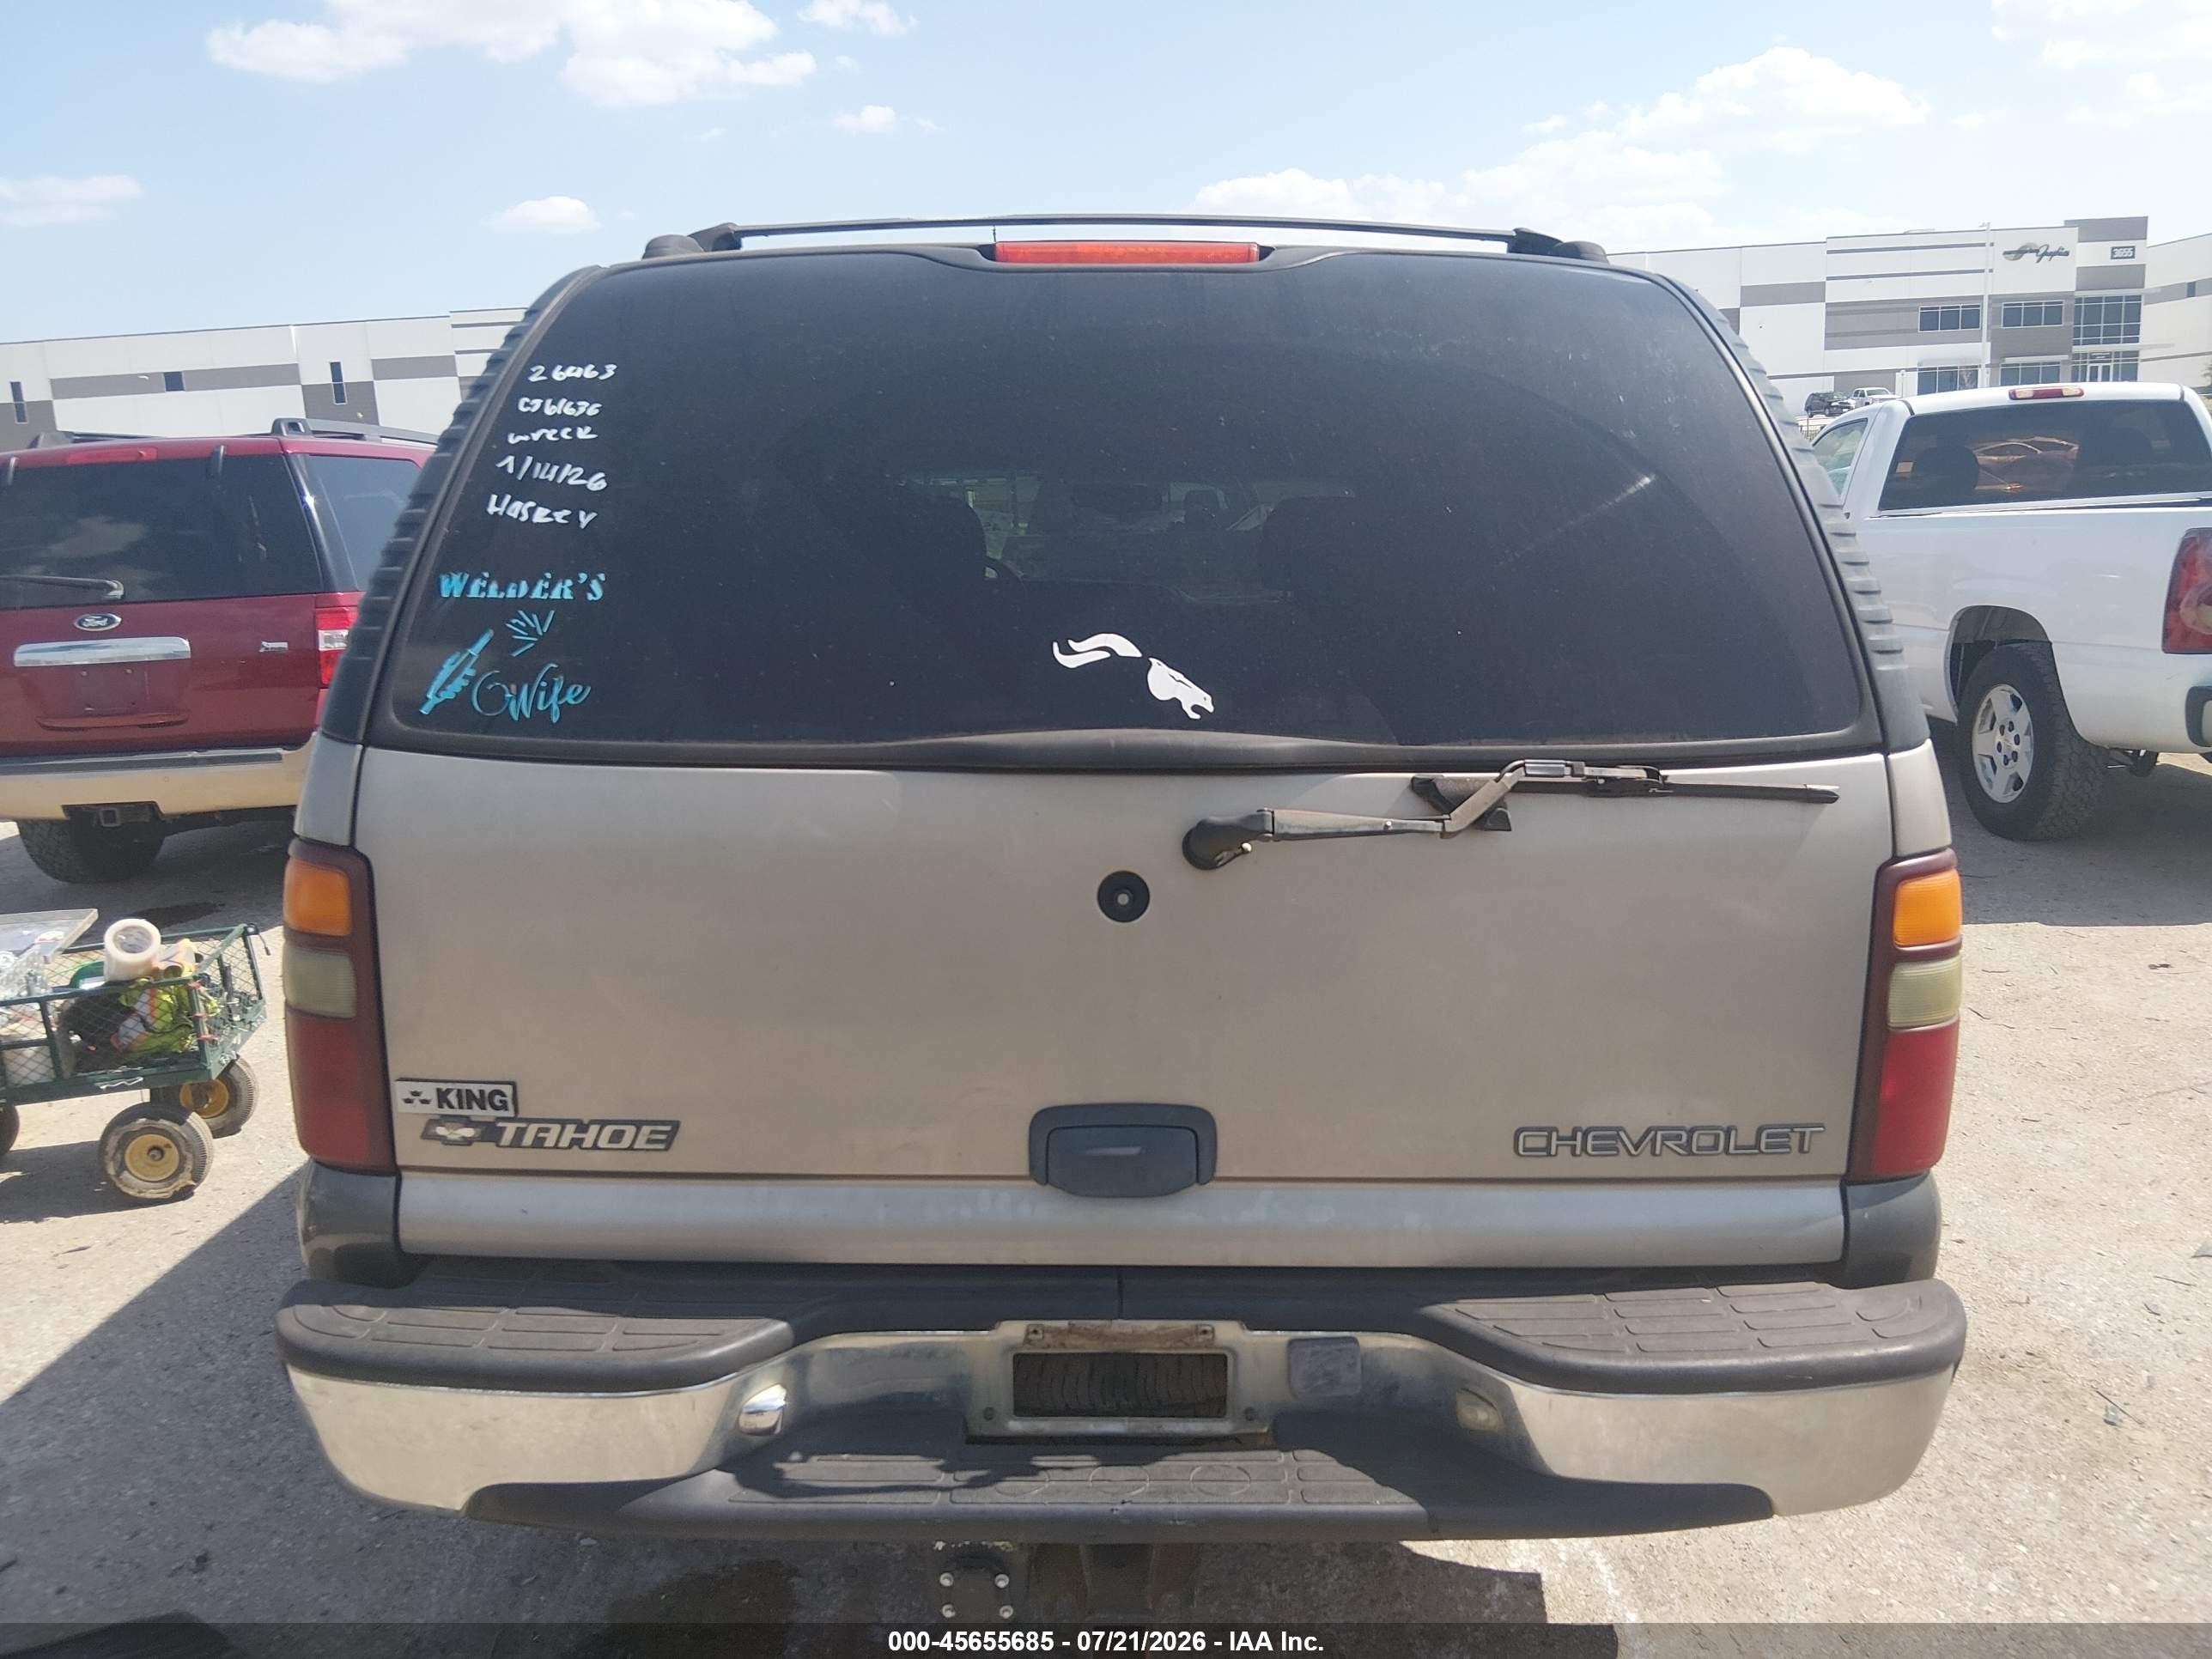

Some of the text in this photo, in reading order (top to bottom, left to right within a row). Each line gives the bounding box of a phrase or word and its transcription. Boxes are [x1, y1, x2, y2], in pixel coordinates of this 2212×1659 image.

[472, 663, 592, 724] Wife
[435, 1087, 509, 1112] KING
[495, 1121, 673, 1150] TAHOE
[1514, 1124, 1826, 1158] CHEVROLET
